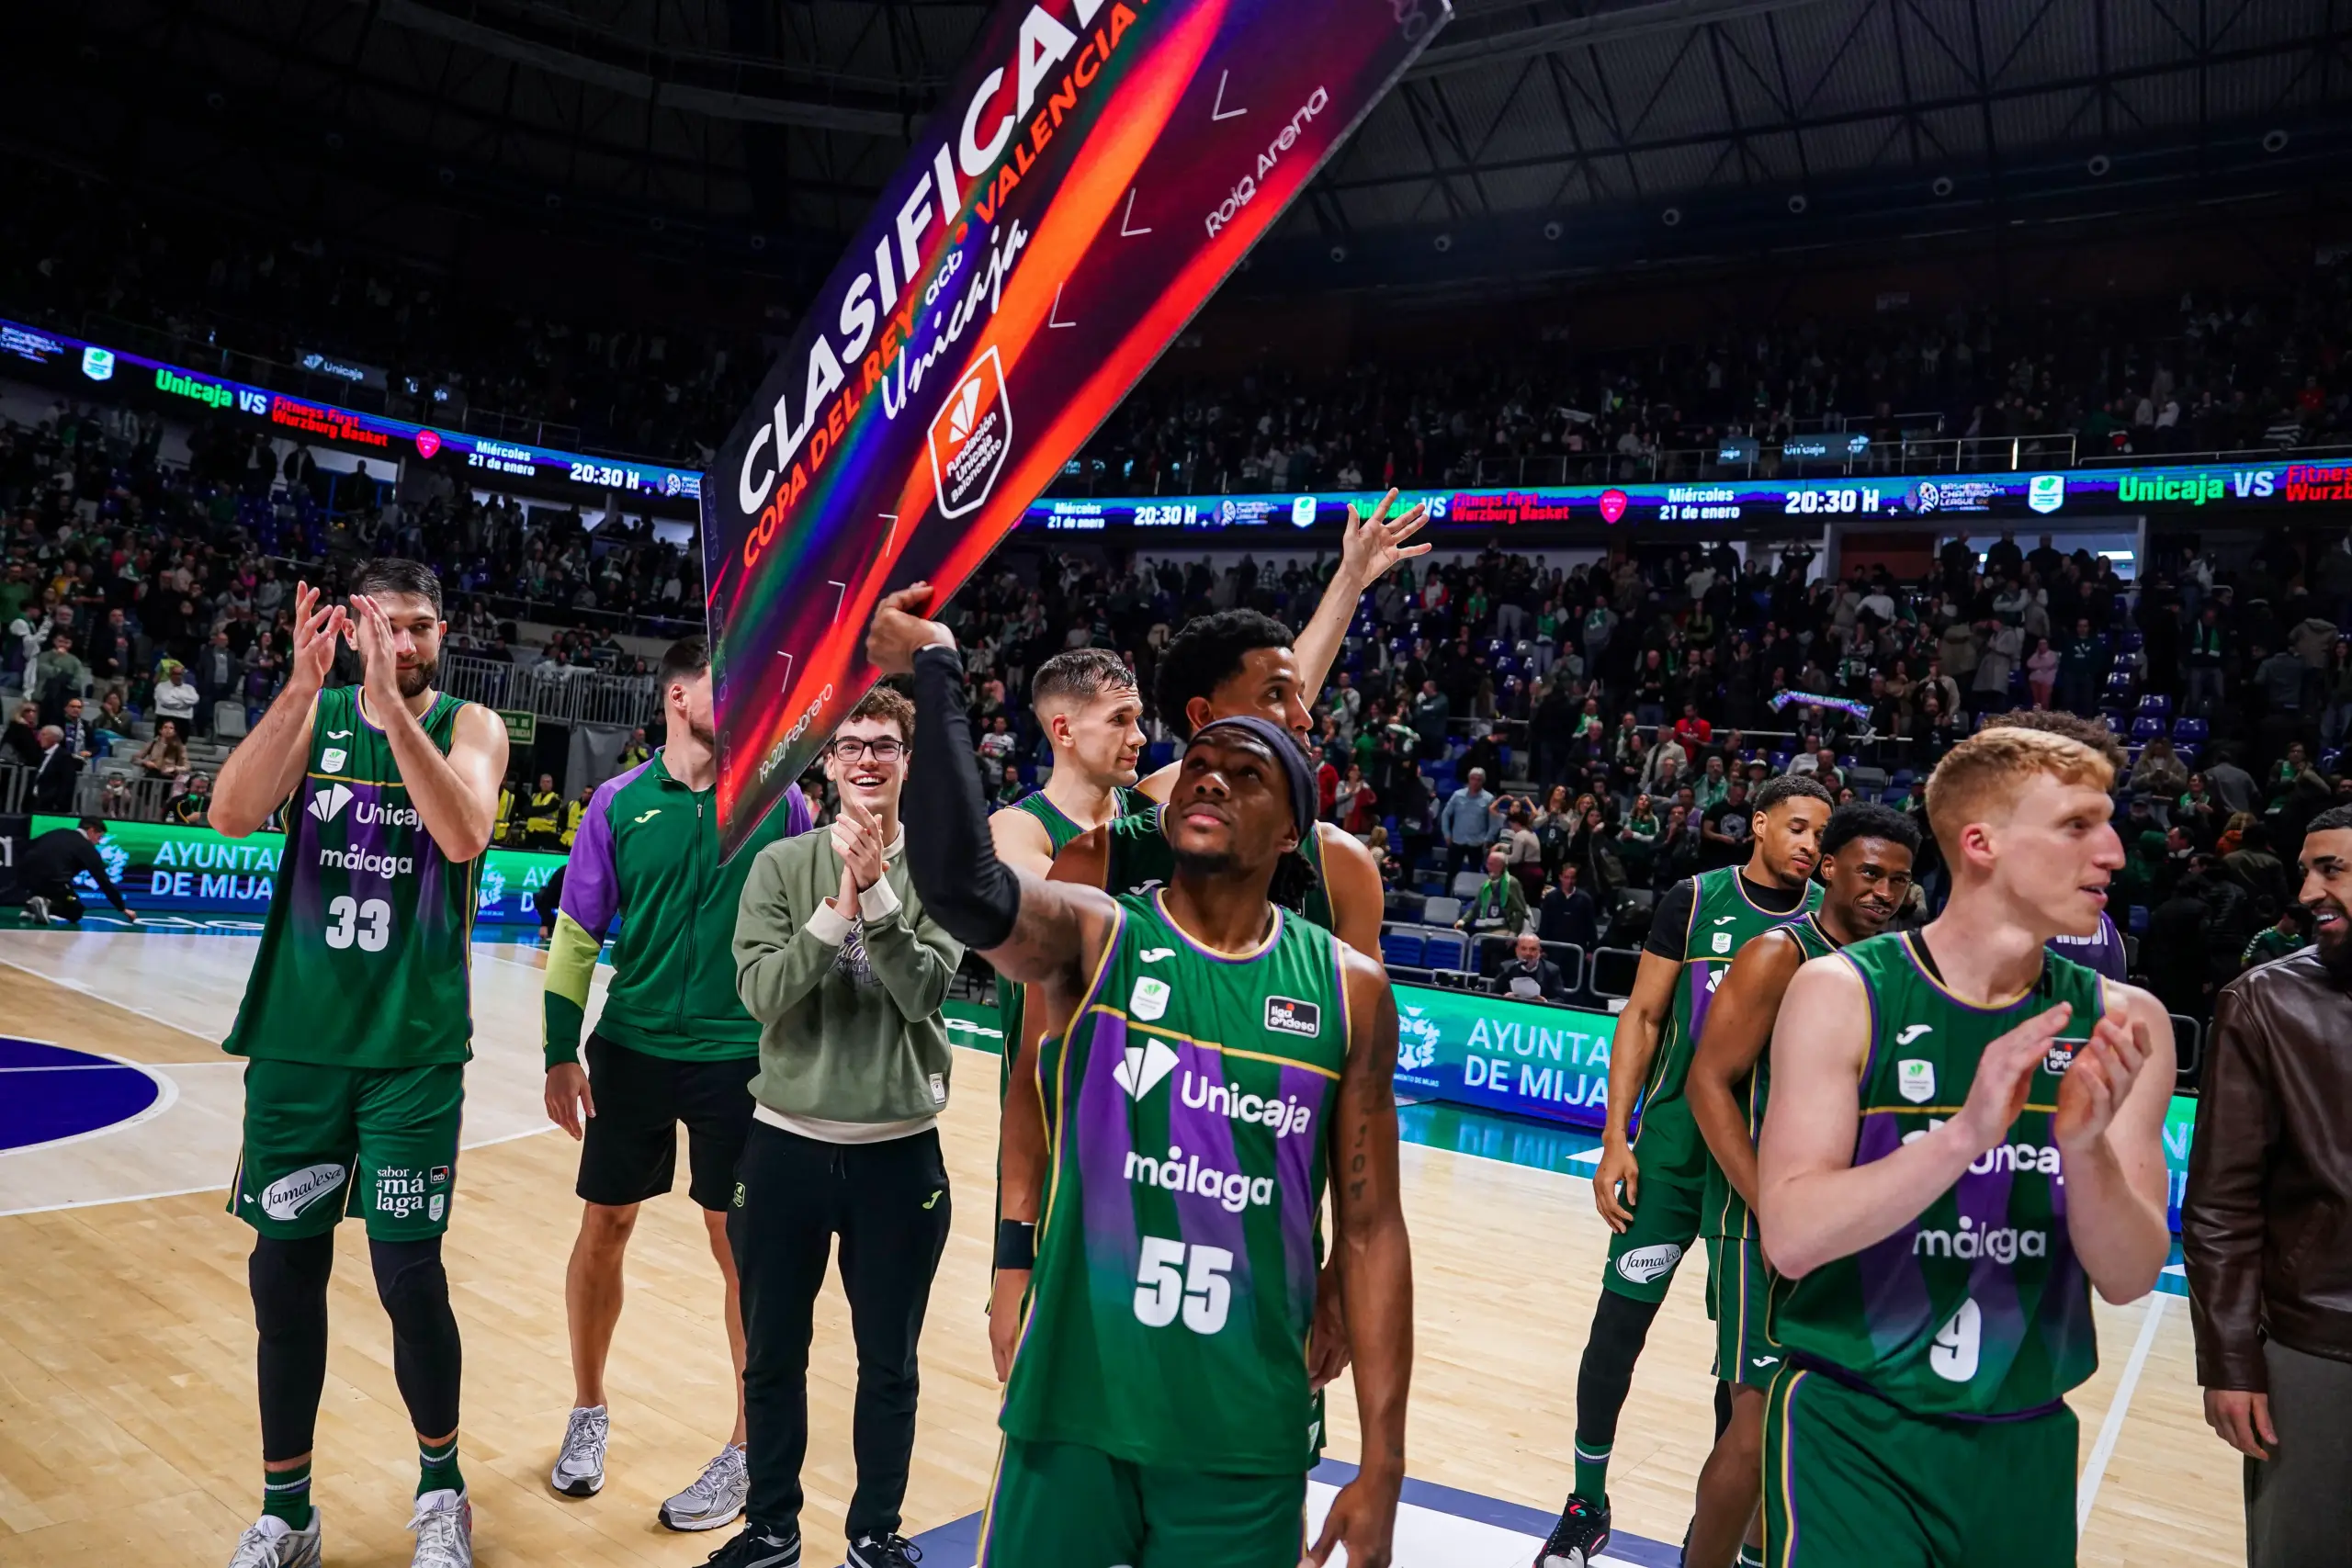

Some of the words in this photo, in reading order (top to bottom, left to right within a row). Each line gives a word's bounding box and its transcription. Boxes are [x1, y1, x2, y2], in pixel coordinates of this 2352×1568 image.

[1257, 85, 1329, 181] Arena
[743, 462, 808, 568] COPA
[810, 387, 861, 472] DEL
[863, 292, 915, 394] REY
[924, 249, 963, 307] acb
[975, 2, 1136, 223] VALENCIA
[882, 218, 1028, 420] Unicaja
[155, 368, 233, 409] Unicaja
[239, 389, 267, 414] VS
[272, 409, 339, 439] Wurzburg
[341, 423, 389, 447] Basket
[274, 396, 324, 420] Fitness
[328, 408, 360, 428] First
[476, 441, 531, 461] Miércoles
[946, 412, 997, 478] Fundación
[956, 434, 993, 482] Unicaja
[468, 453, 484, 468] 21
[487, 457, 501, 469] de
[503, 461, 535, 477] enero
[570, 462, 624, 488] 20:30
[951, 439, 1002, 503] Baloncesto
[1453, 492, 1502, 507] Fitness
[1507, 491, 1539, 506] First
[1668, 487, 1735, 503] Miércoles
[1784, 490, 1857, 514] 20:30
[1862, 489, 1880, 513] H
[2118, 473, 2224, 505] Unicaja
[2233, 470, 2275, 497] VS
[1047, 515, 1062, 529] 21
[1063, 515, 1076, 528] de
[1077, 517, 1105, 529] enero
[1054, 502, 1102, 514] Miércoles
[1134, 505, 1182, 525] 20:30
[1659, 505, 1678, 520] 21
[1681, 505, 1698, 520] de
[1701, 506, 1740, 519] enero
[153, 840, 284, 873] AYUNTA
[151, 871, 194, 897] DE
[325, 896, 391, 952] 33
[1270, 1016, 1316, 1032] endesa
[1271, 1005, 1293, 1019] liga
[1464, 1055, 1511, 1092] DE
[1181, 1069, 1311, 1139] Unicaja
[376, 1179, 383, 1188] a
[377, 1165, 410, 1178] sabor
[433, 1172, 446, 1181] acb
[1123, 1145, 1274, 1213] málaga
[265, 1168, 343, 1212] famadesa
[376, 1190, 425, 1218] laga
[1133, 1235, 1234, 1335] 55
[1929, 1297, 1982, 1382] 9
